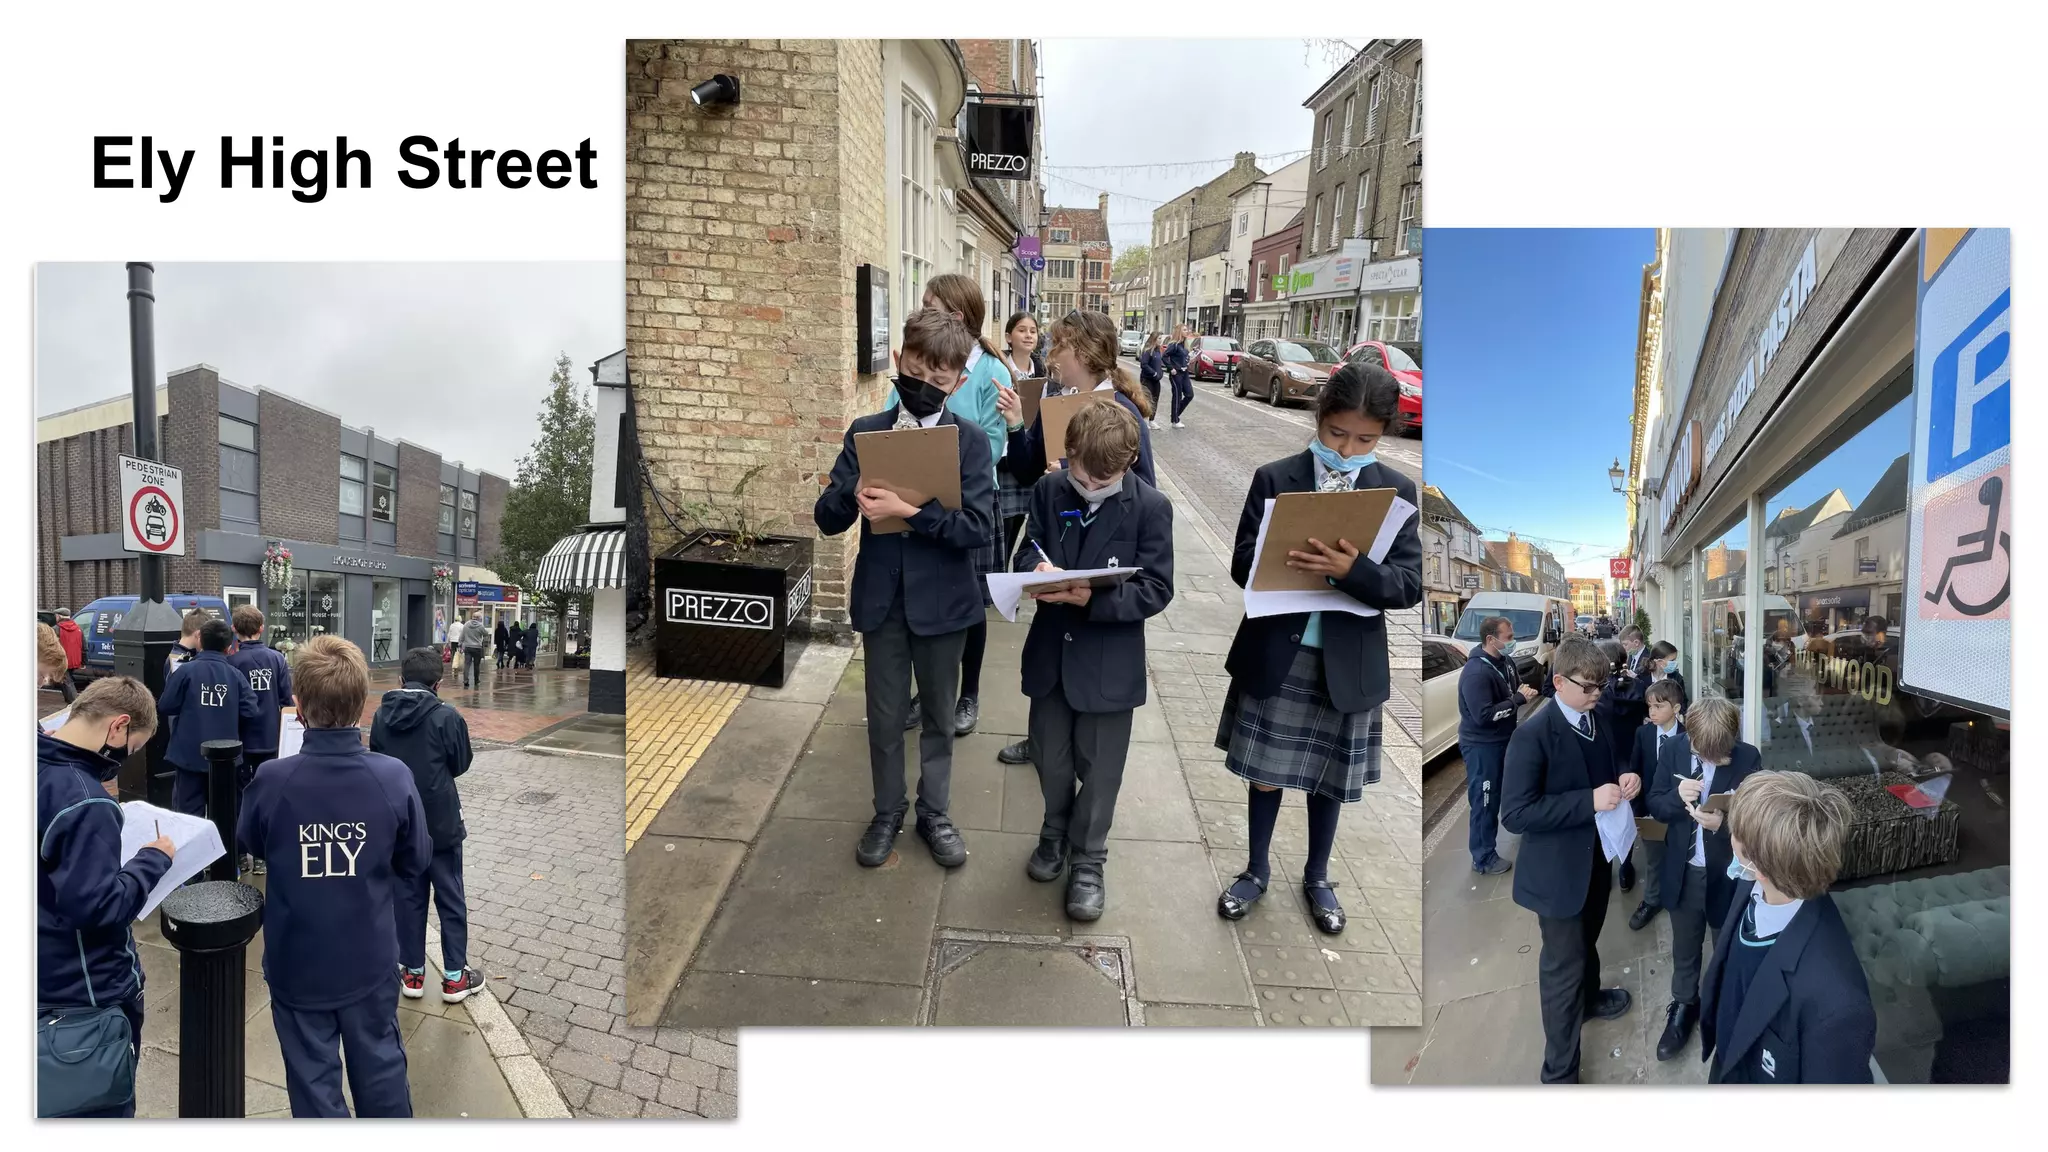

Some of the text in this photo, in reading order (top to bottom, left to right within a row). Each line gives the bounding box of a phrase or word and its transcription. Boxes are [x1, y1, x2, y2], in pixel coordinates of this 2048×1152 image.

[970, 153, 1027, 172] PREZZO
[1728, 355, 1757, 430] PIZZA
[1759, 235, 1818, 377] PASTA
[1952, 305, 2010, 459] P
[125, 459, 178, 480] PEDESTRIAN
[141, 473, 165, 487] ZONE
[788, 573, 811, 616] PREZZO
[672, 594, 769, 624] PREZZO
[201, 682, 228, 692] KIG'S
[250, 676, 272, 691] ELY
[200, 690, 227, 707] ELY
[298, 822, 367, 842] KING'S
[300, 841, 366, 879] ELY
